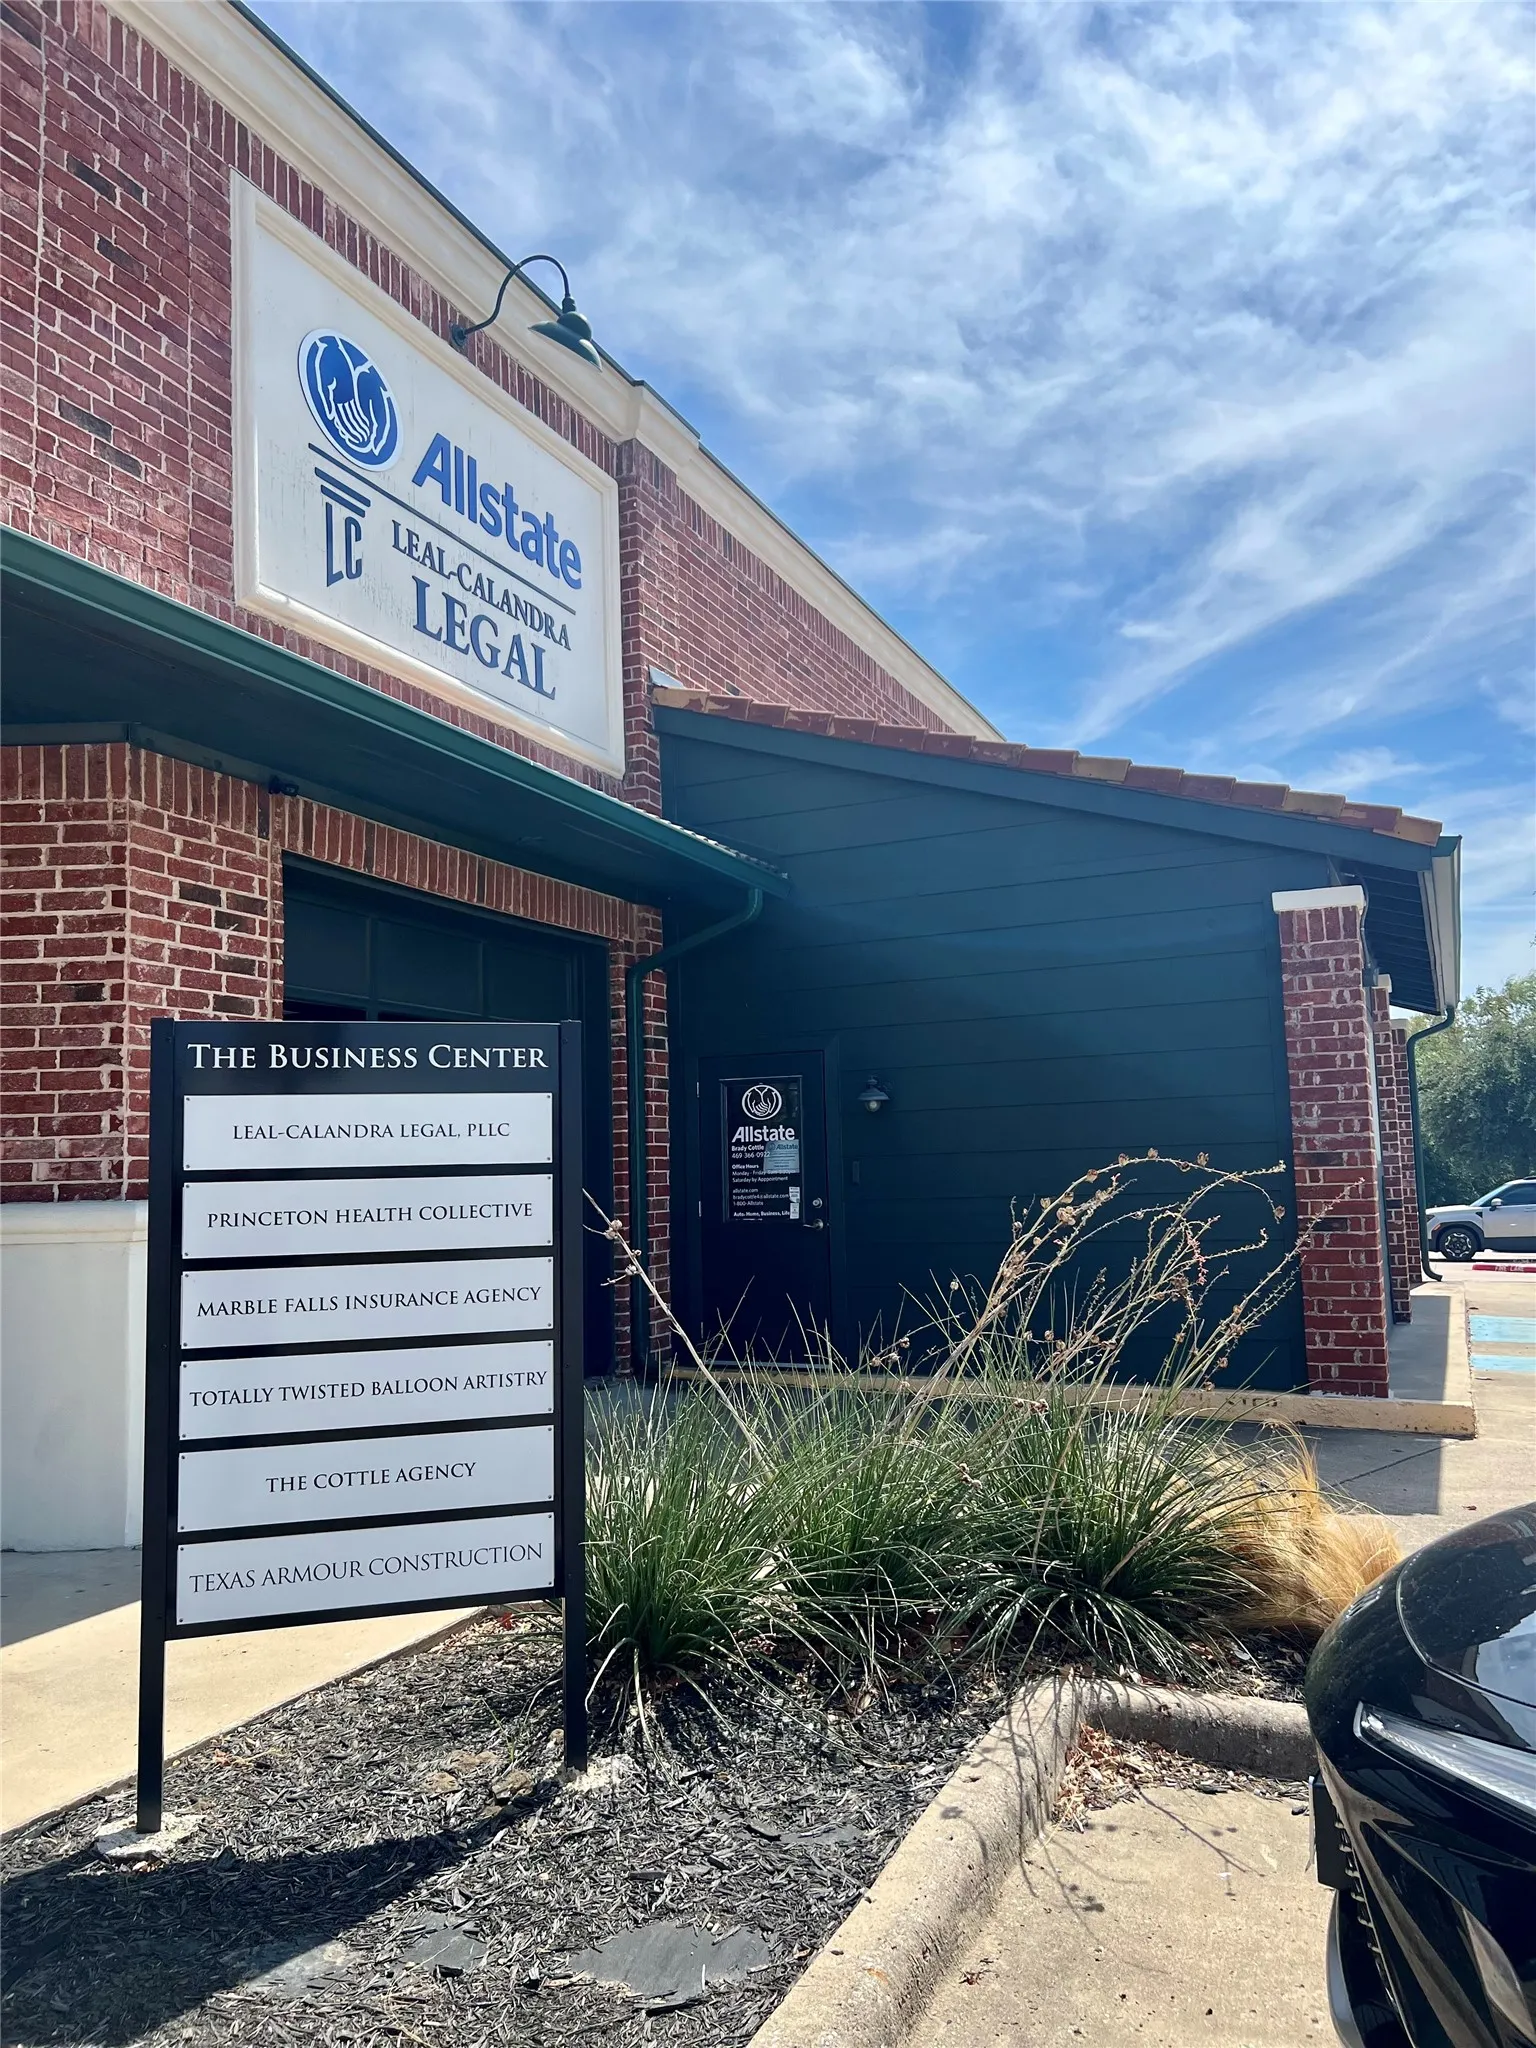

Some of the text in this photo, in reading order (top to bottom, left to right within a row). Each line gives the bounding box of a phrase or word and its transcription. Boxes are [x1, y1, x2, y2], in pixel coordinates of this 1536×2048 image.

[413, 433, 582, 589] Allstate
[392, 520, 572, 651] LEAL-CALANDRA
[412, 576, 556, 700] LEGAL
[234, 1123, 509, 1139] LEAL-CALANDRA LEGAL, PLLC
[731, 1125, 795, 1143] Allstate
[208, 1203, 532, 1227] PRINCETON HEALTH COLLECTIVE
[198, 1287, 540, 1316] MARBLE FALLS INSURANCE AGENCY
[190, 1371, 546, 1406] TOTALLY TWISTED BALLOON ARTISTRY
[266, 1463, 475, 1492] THE COTTLE AGENCY
[189, 1543, 541, 1592] TEXAS ARMOUR CONSTRUCTION
